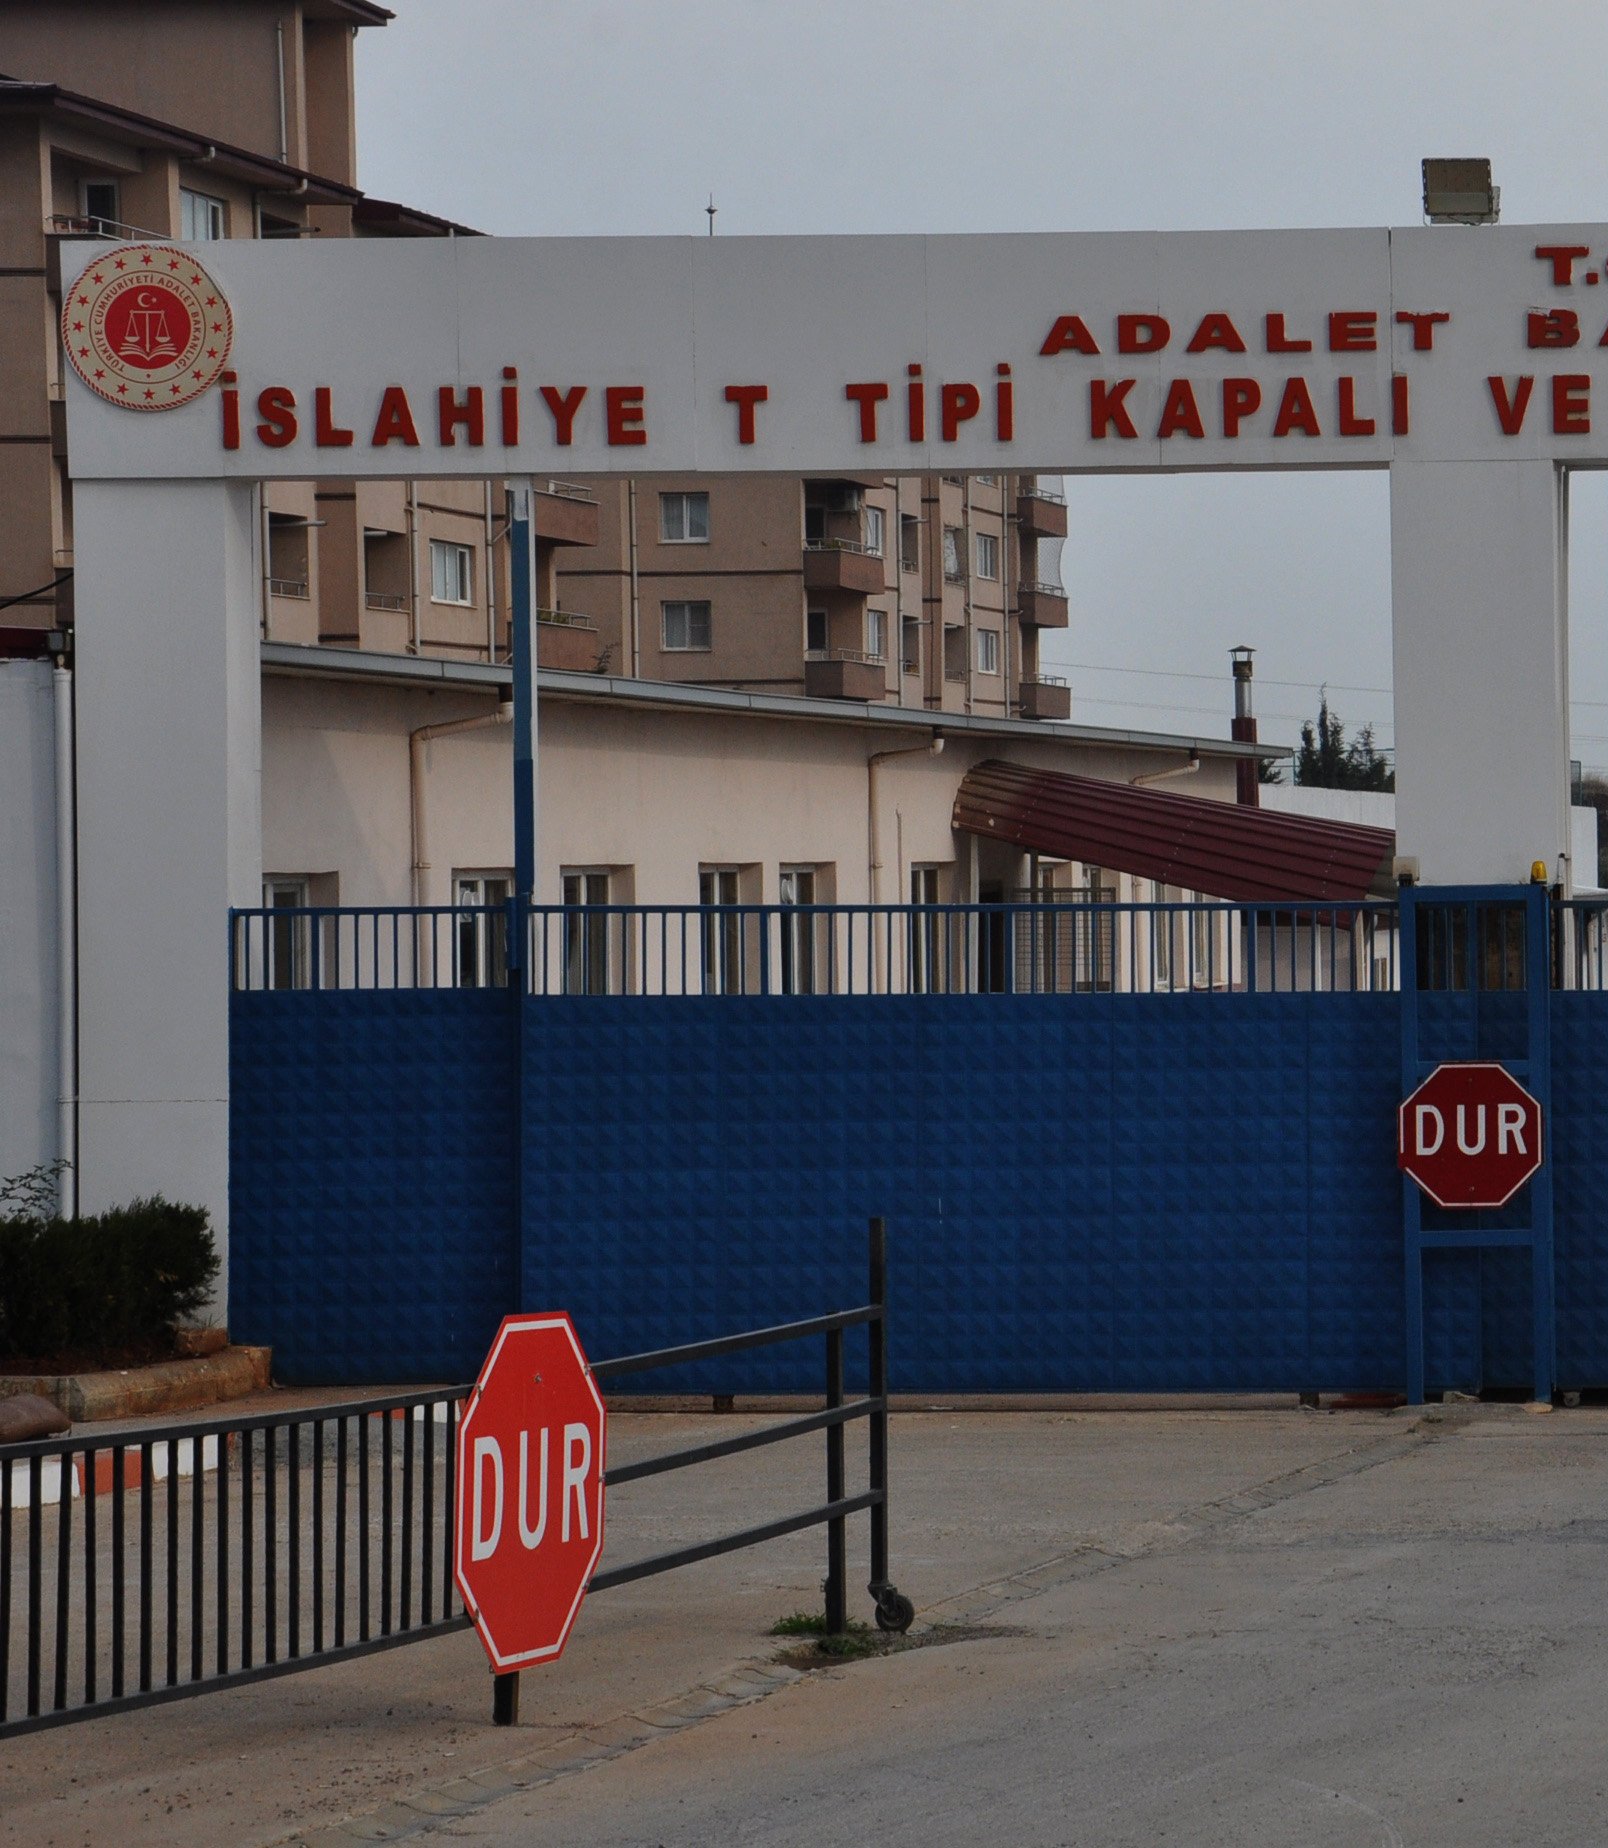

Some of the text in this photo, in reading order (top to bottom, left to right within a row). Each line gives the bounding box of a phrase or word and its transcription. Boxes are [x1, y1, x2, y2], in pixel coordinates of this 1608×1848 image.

[95, 274, 154, 325] CUMHURİYETİ
[158, 277, 195, 308] ADALET
[95, 327, 126, 373] TÜRKİYE
[1042, 311, 1449, 354] ADALET
[223, 368, 648, 448] İSLAHİYE
[726, 386, 769, 443] T
[847, 364, 1014, 441] TİPİ
[1091, 376, 1409, 437] KAPALI
[1490, 375, 1591, 433] VE
[1415, 1103, 1528, 1156] DUR
[471, 1422, 592, 1562] DUR
